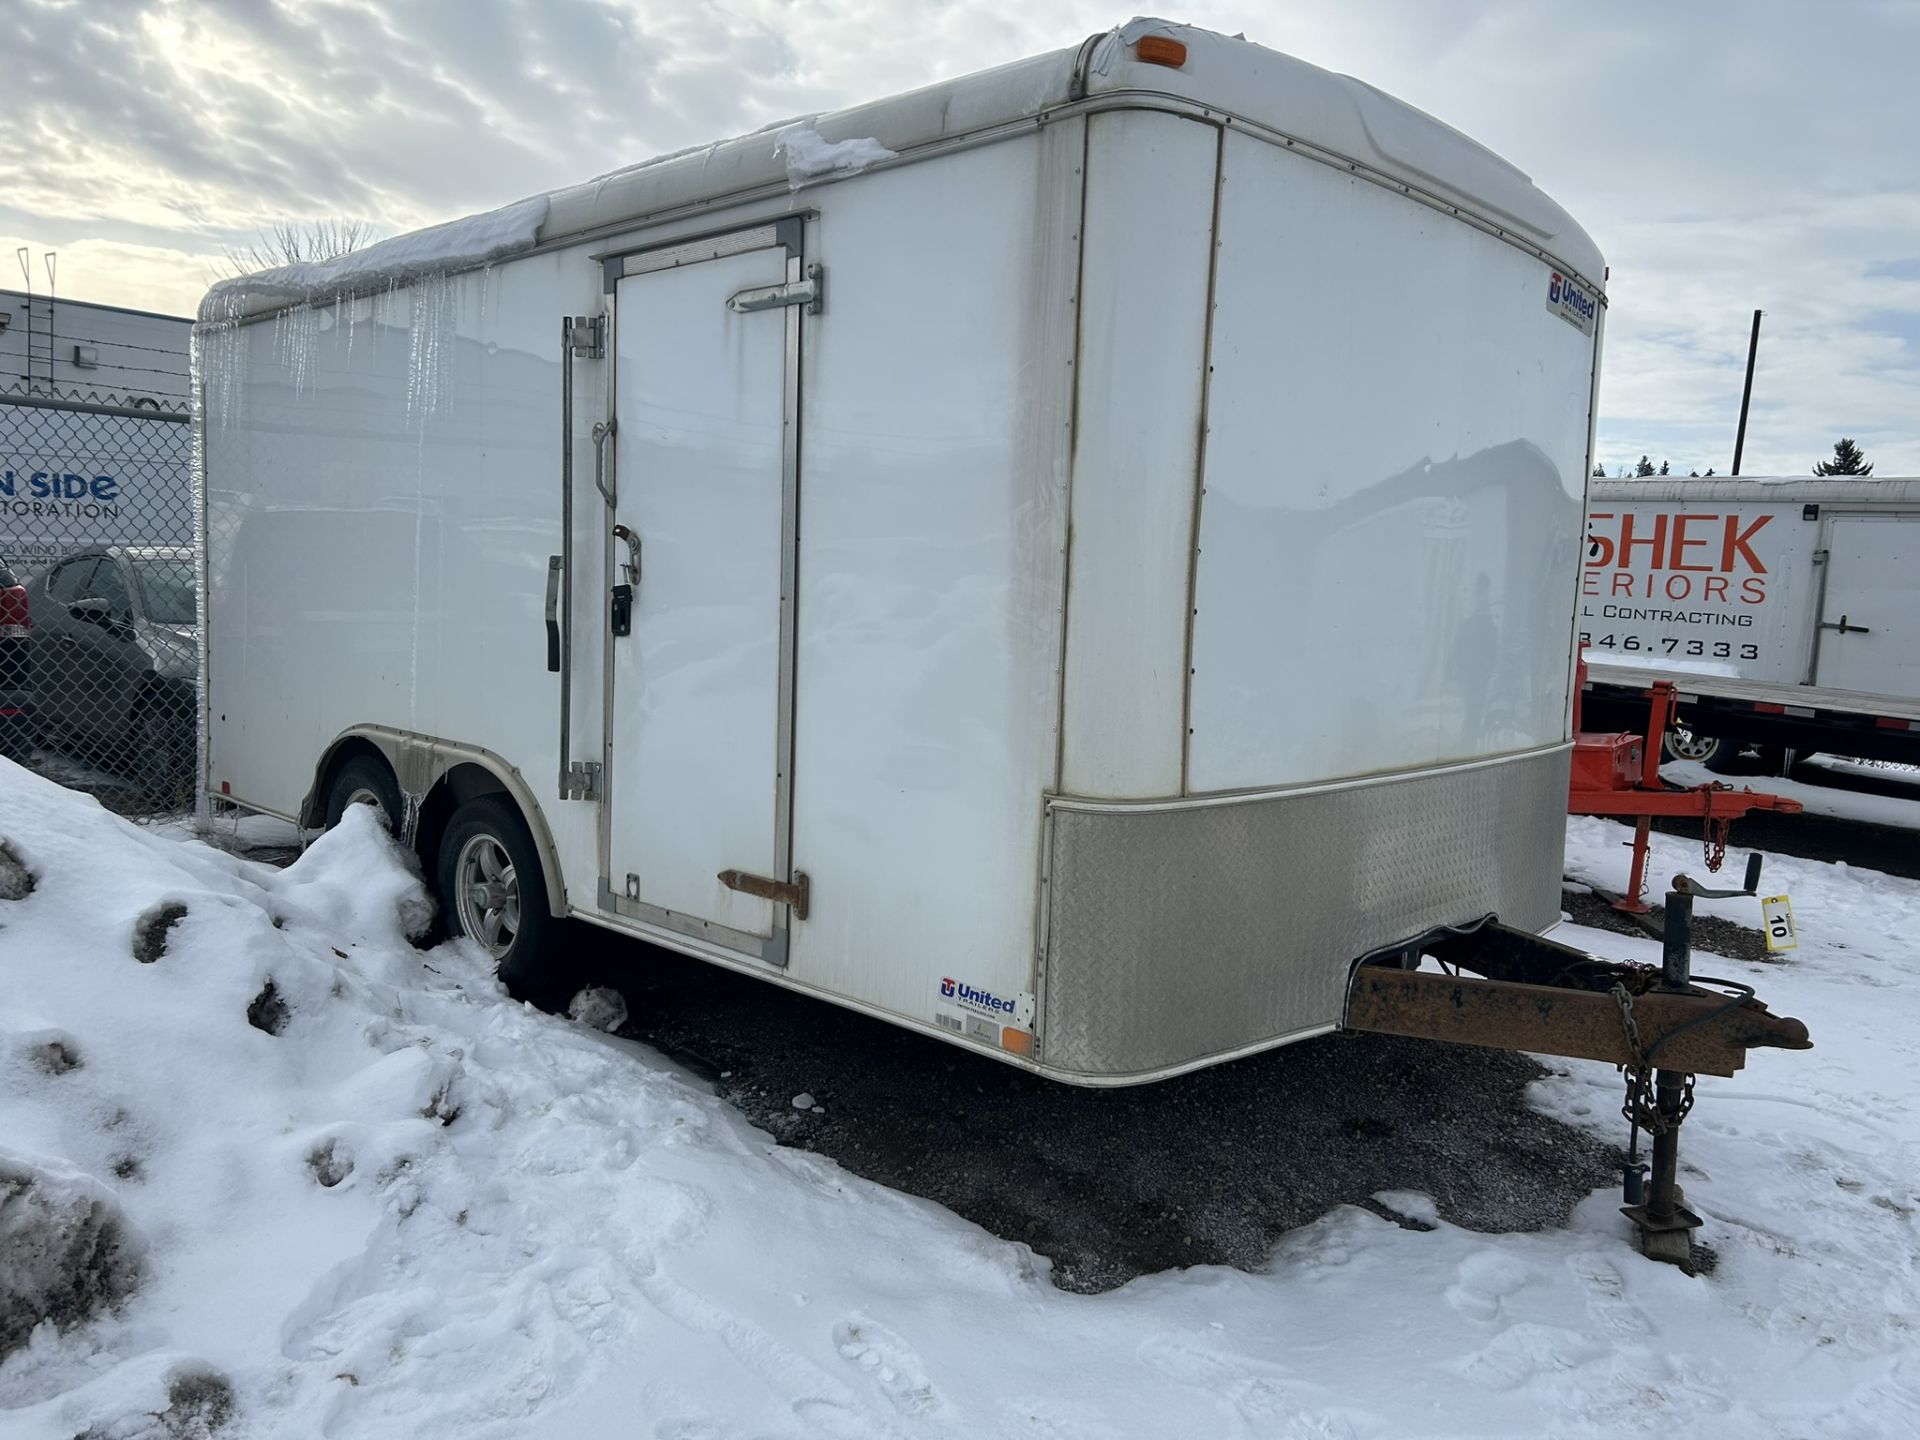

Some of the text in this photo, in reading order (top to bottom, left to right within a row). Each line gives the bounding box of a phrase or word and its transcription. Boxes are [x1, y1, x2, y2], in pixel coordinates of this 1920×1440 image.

[1562, 279, 1595, 320] United
[1583, 571, 1767, 605] ERIORS
[1770, 915, 1787, 938] 10
[957, 982, 1016, 1014] United
[958, 996, 1000, 1015] TRAILERS
